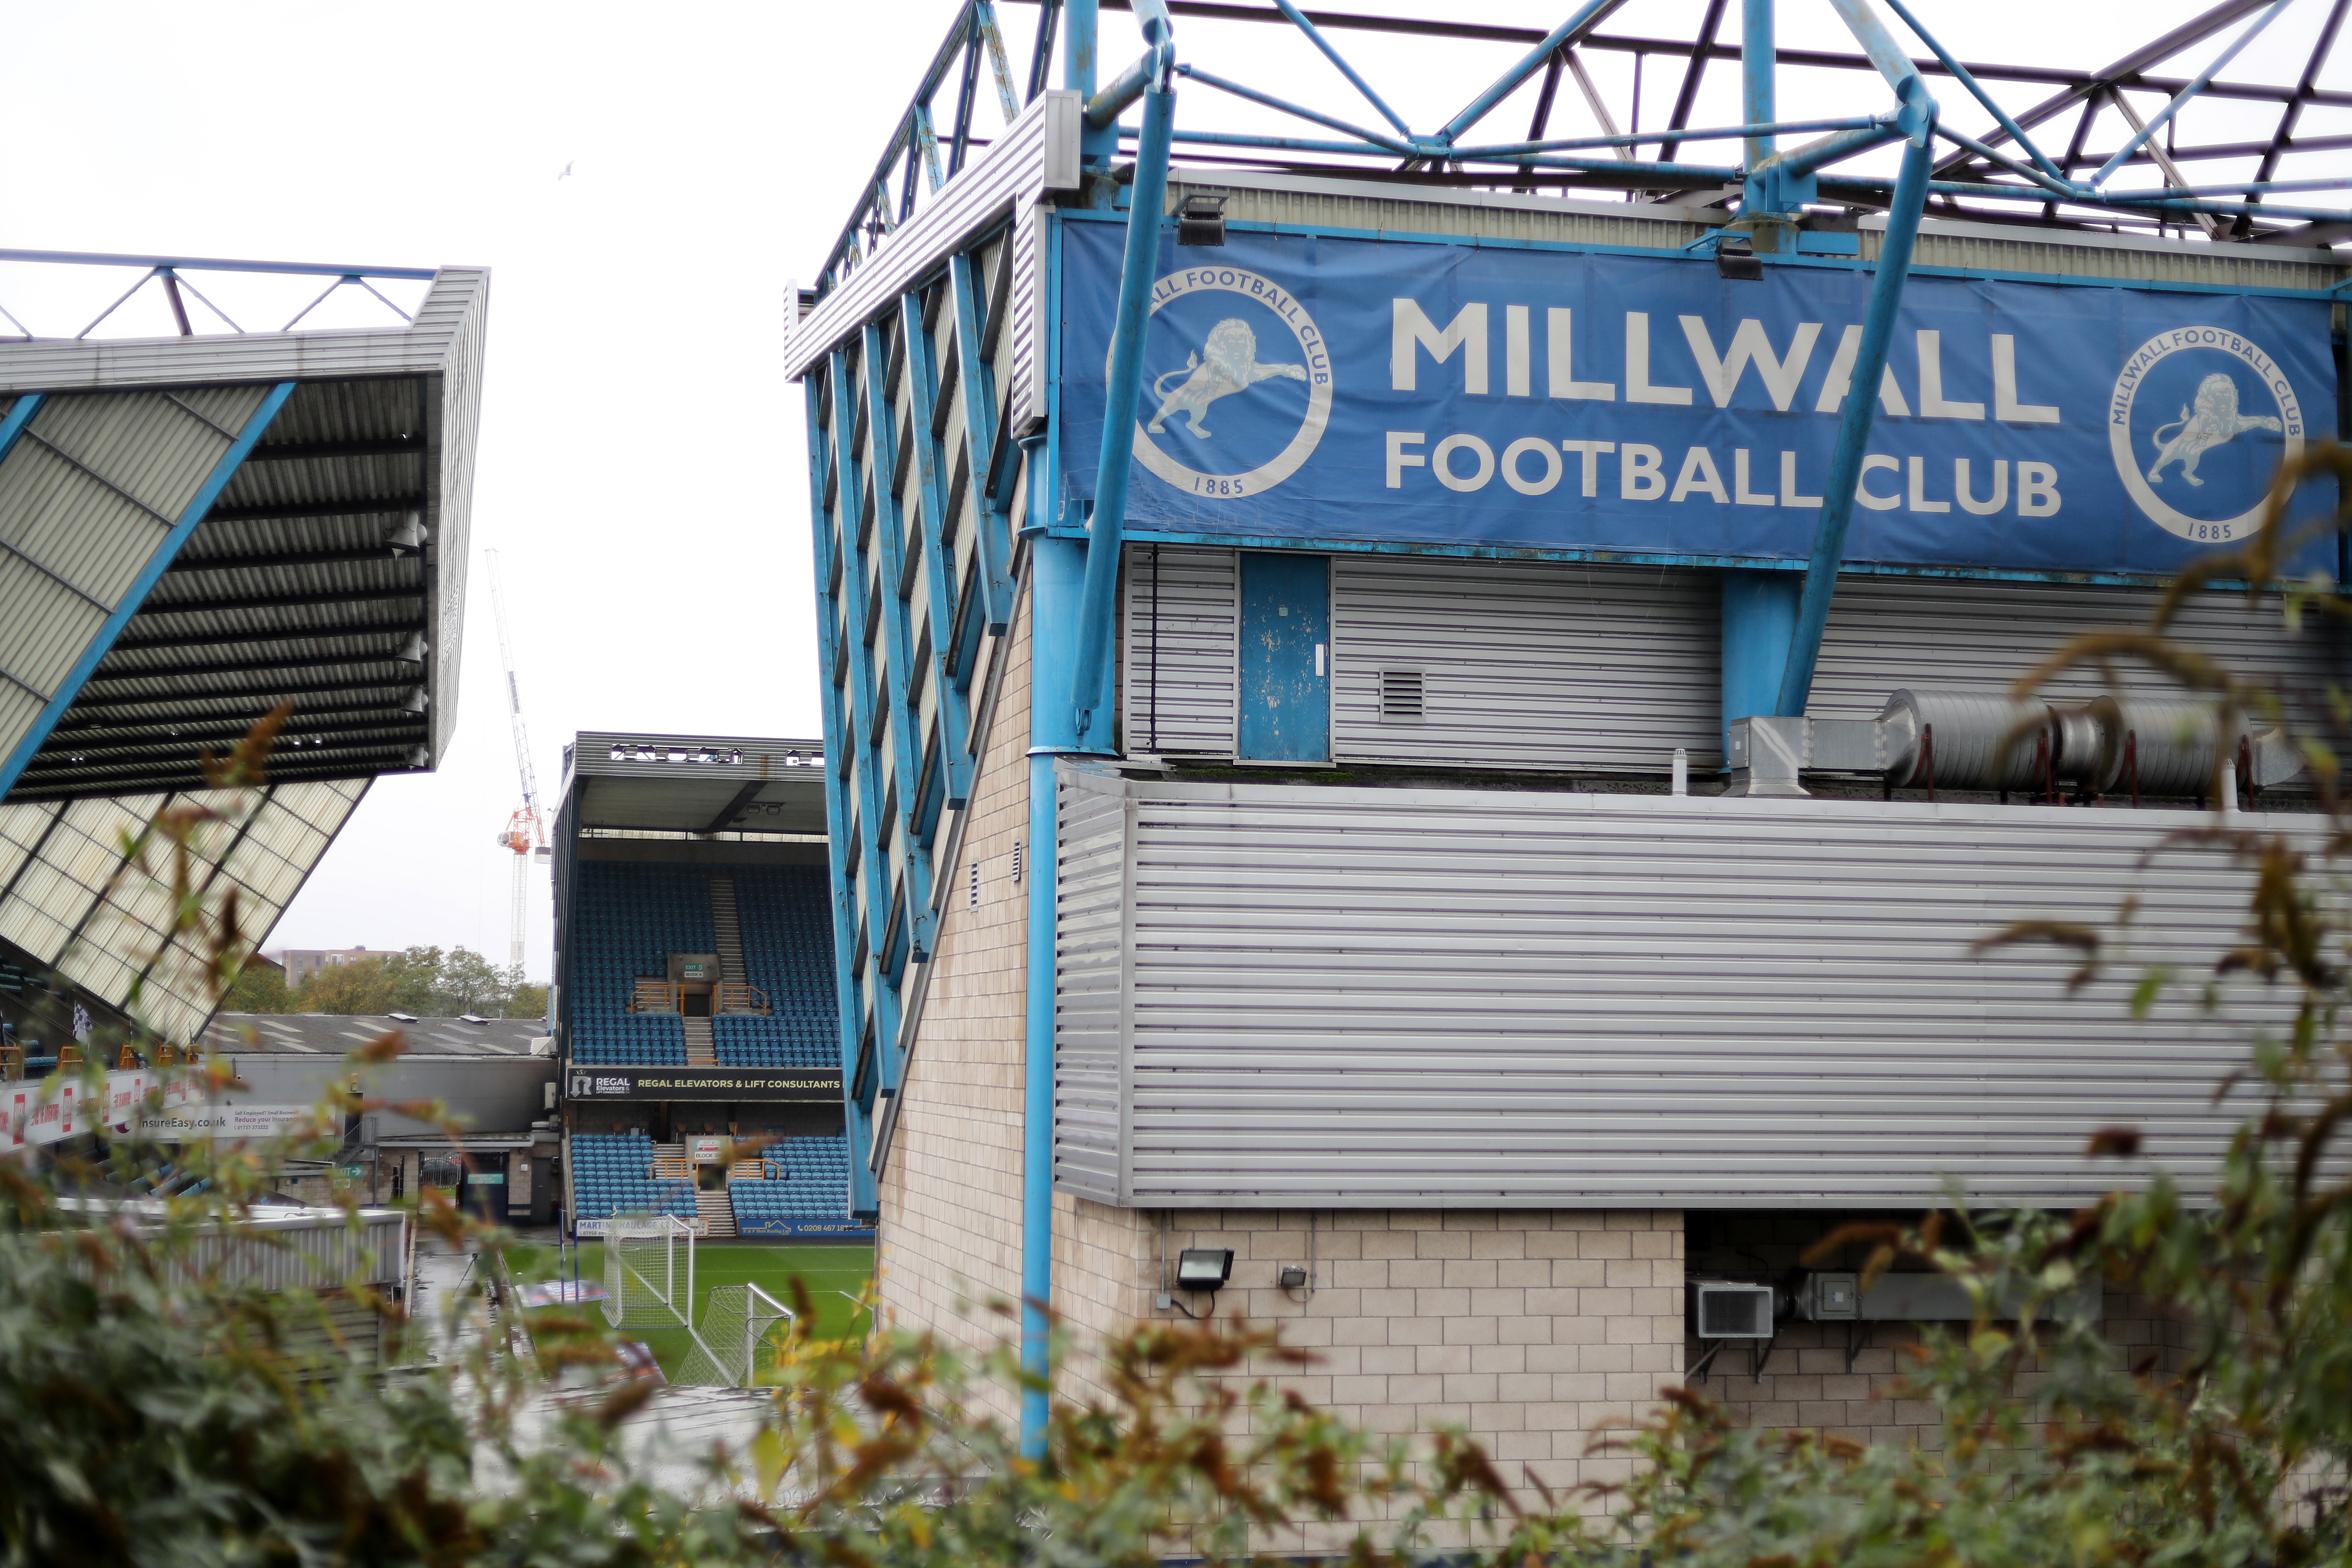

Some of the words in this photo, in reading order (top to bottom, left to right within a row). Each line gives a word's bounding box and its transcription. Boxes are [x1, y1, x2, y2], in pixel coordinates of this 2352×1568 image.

[1186, 270, 1298, 324] FOOTBALL
[1300, 325, 1329, 385] CLUB
[1393, 298, 2060, 423] MILLWALL
[2112, 339, 2171, 425] MILLWALL
[2172, 330, 2271, 378] FOOTBALL
[2274, 380, 2301, 436] CLUB
[1386, 431, 1823, 508] FOOTBALL
[1855, 453, 2062, 518] CLUB
[1194, 479, 1244, 495] 1885
[2188, 522, 2232, 540] 1885
[596, 1078, 631, 1086] REGAL
[638, 1079, 672, 1087] REGAL
[674, 1080, 733, 1088] ELEVATORS
[767, 1080, 840, 1088] CONSULTANTS
[140, 1117, 226, 1130] nsureEasy.co.uk
